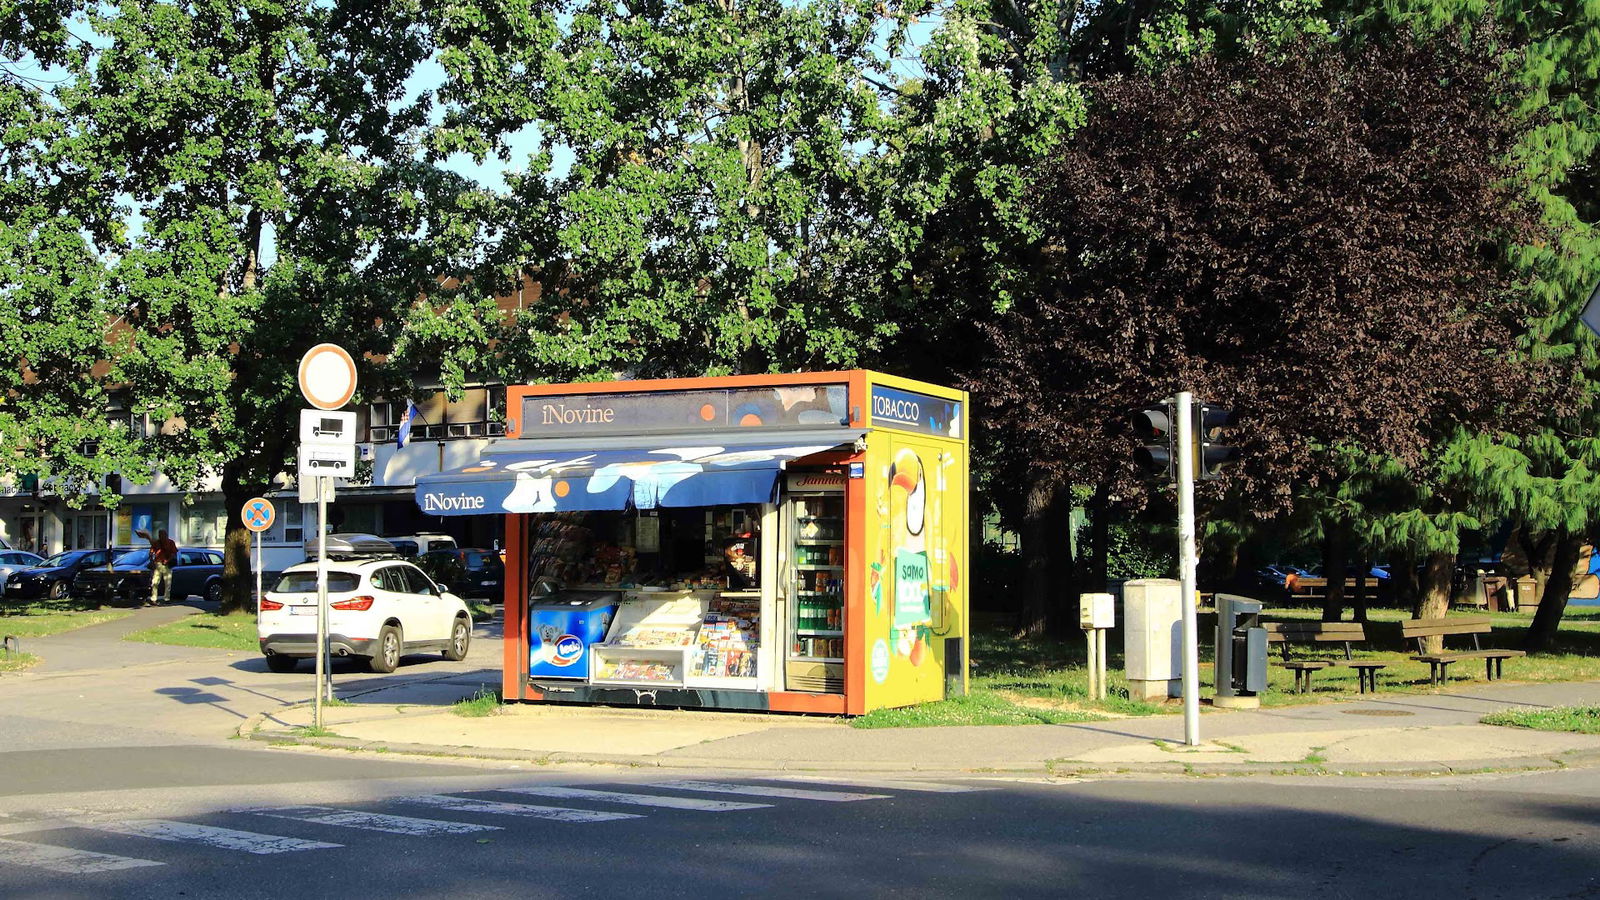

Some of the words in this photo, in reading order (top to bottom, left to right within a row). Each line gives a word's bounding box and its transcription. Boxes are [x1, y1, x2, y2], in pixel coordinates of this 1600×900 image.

[542, 404, 614, 424] iNovine
[873, 395, 919, 421] TOBACCO
[424, 492, 485, 511] iNovine
